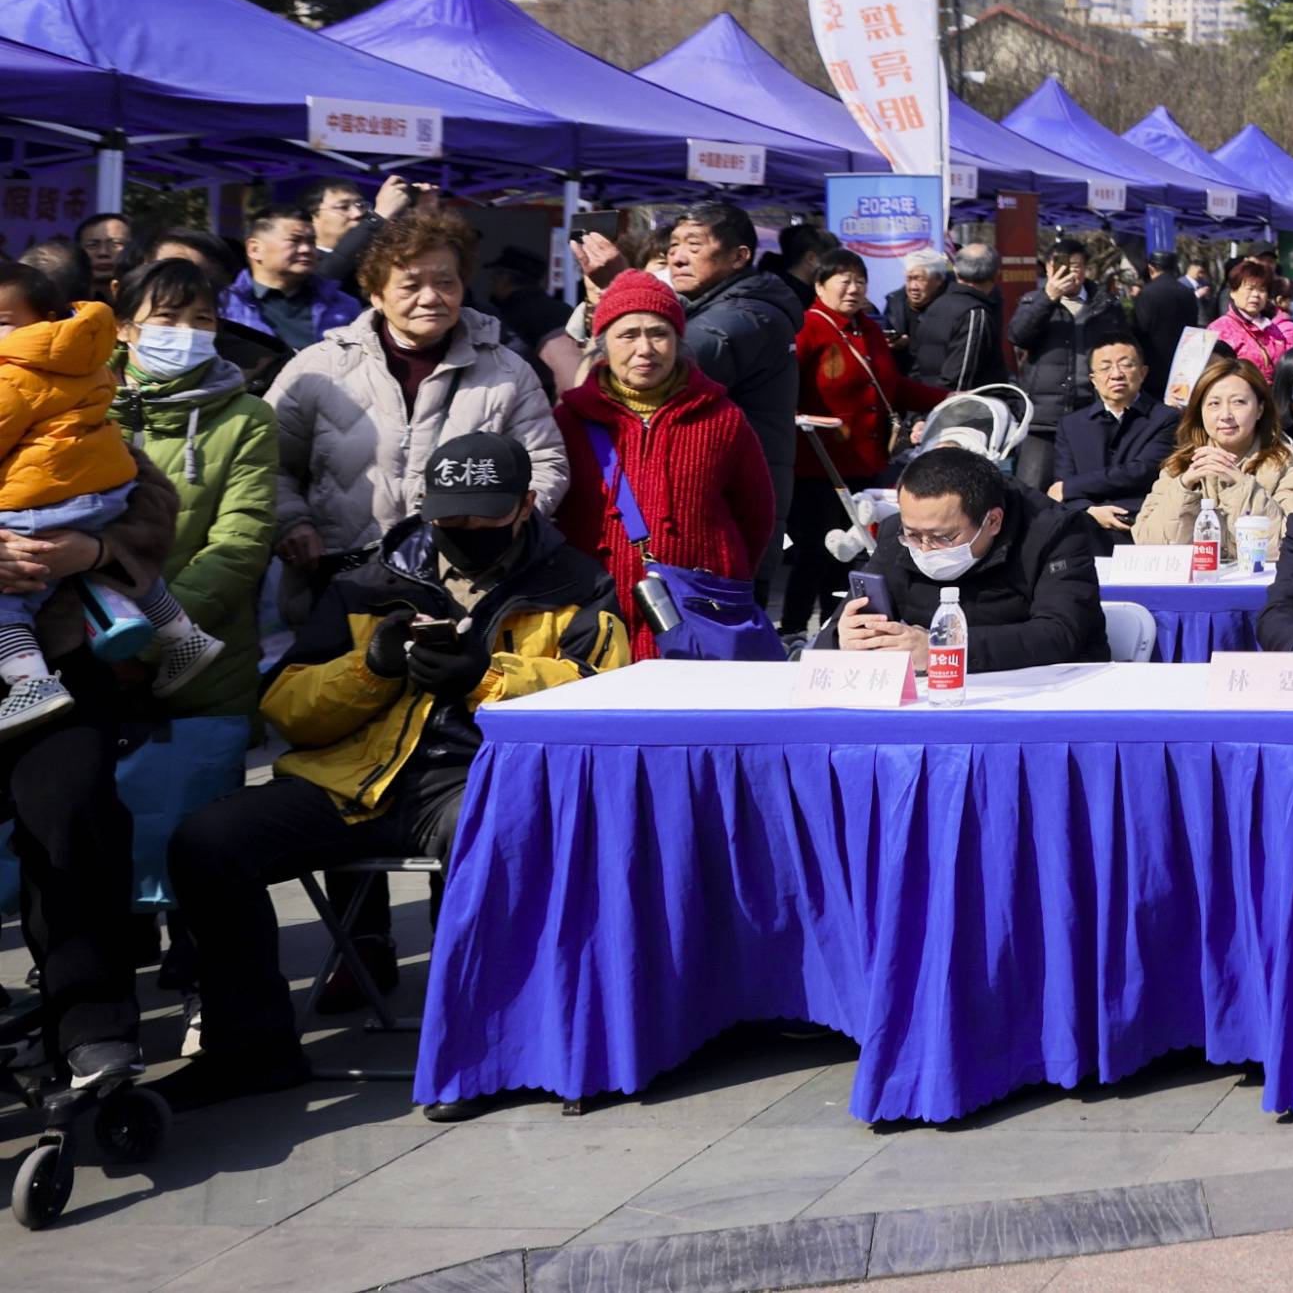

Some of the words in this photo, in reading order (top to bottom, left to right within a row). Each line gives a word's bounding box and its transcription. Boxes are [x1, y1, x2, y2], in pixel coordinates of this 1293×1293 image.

[326, 112, 408, 138] 中国农业银行
[859, 196, 916, 215] 2024年
[433, 457, 503, 487] 怎樣
